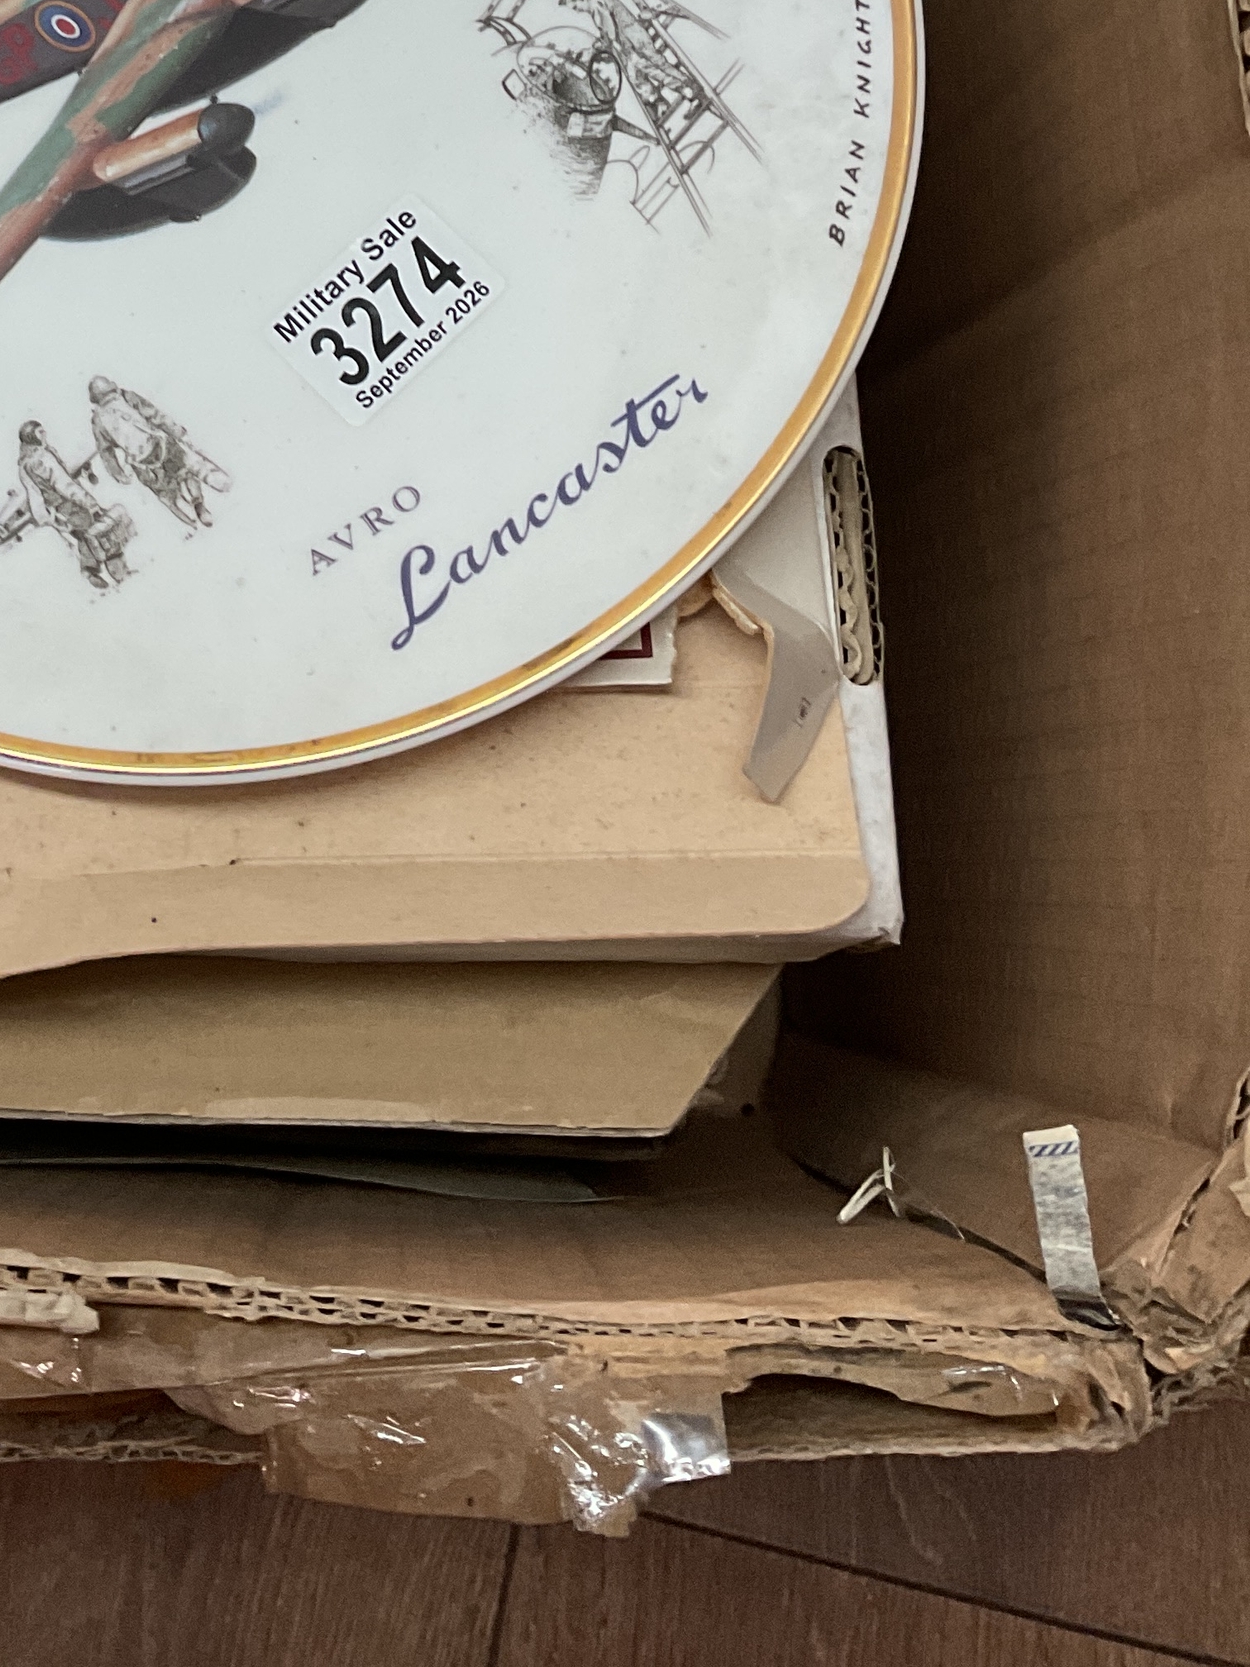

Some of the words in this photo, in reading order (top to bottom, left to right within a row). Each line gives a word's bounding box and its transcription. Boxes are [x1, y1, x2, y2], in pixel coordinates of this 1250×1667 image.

[828, 140, 866, 247] BRIAN
[273, 257, 366, 344] Military
[361, 210, 417, 262] Sale
[310, 235, 466, 386] 3274
[355, 321, 448, 410] September
[445, 280, 490, 325] 2026
[308, 485, 421, 576] AVRO
[391, 374, 708, 650] Lancaster
